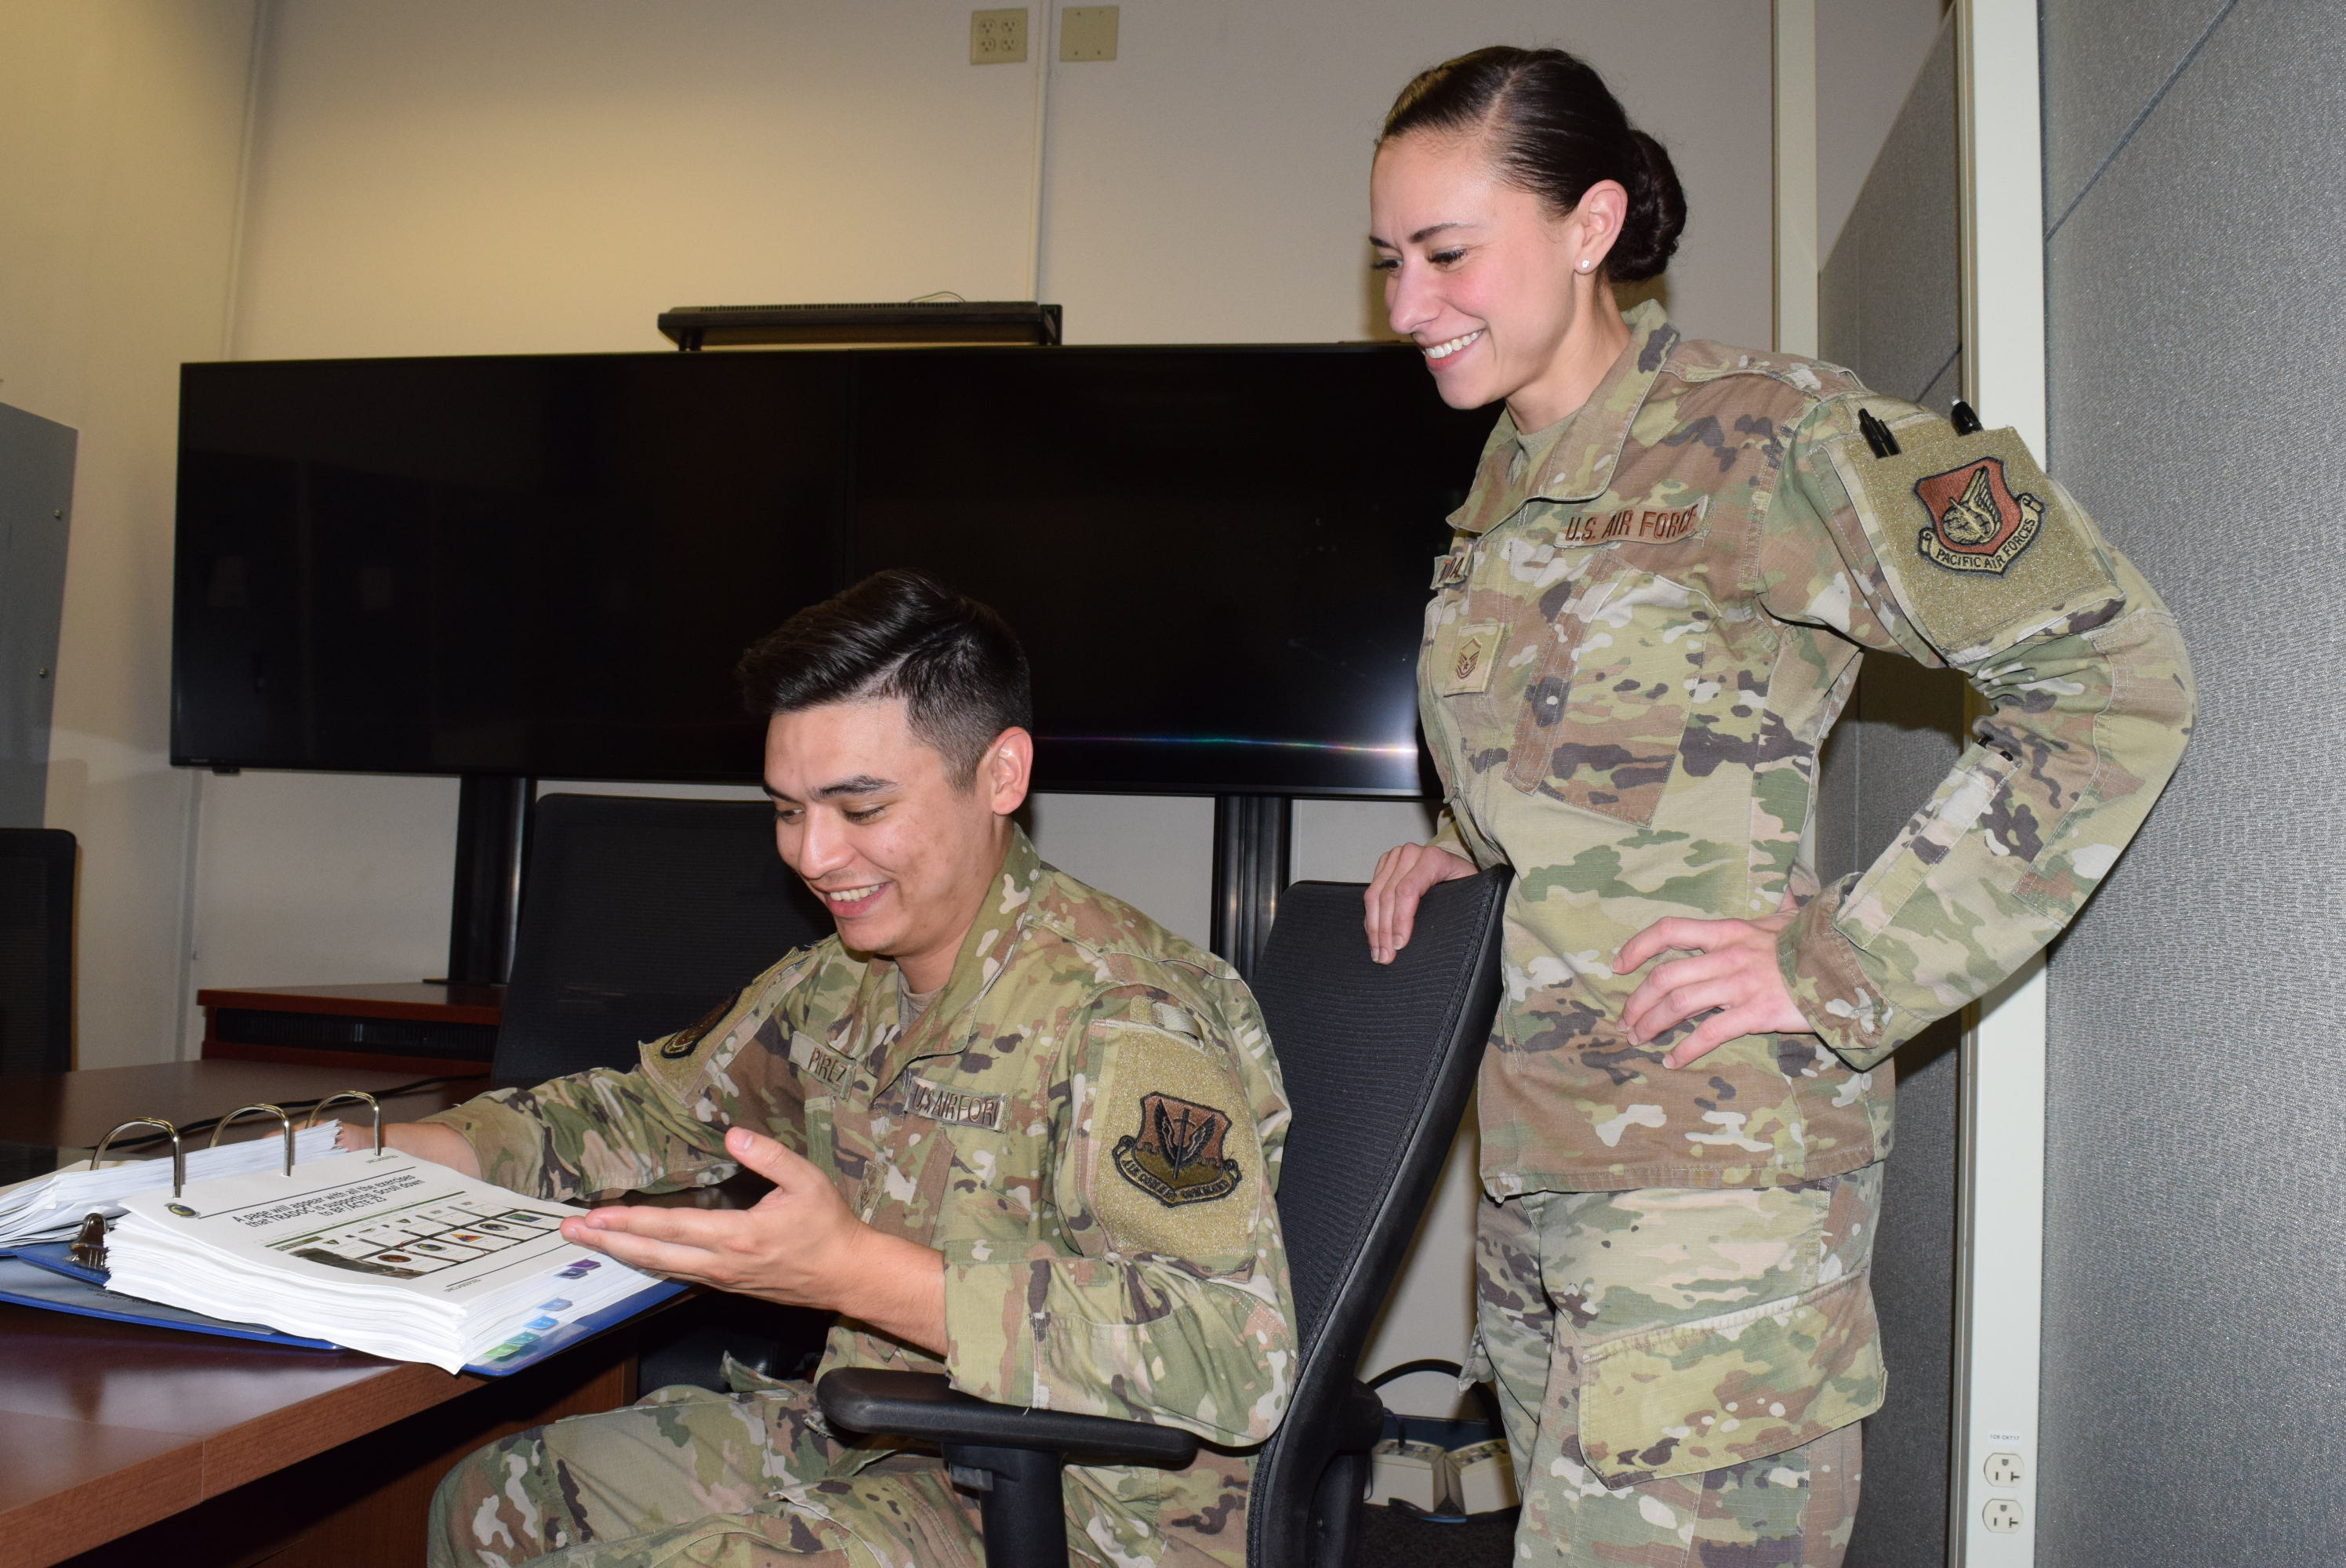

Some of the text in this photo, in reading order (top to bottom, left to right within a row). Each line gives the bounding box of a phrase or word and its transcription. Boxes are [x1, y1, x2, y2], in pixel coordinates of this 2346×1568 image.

[1565, 516, 1598, 542] U.S.
[1601, 510, 1635, 539] AIR
[1936, 517, 2036, 568] PACIFIC AIR FORCES
[932, 1090, 958, 1120] AIR
[243, 1210, 271, 1221] page
[270, 1204, 292, 1214] will
[290, 1197, 325, 1209] appear
[323, 1191, 348, 1200] with
[245, 1218, 274, 1228] that
[267, 1207, 315, 1221] TRADOC
